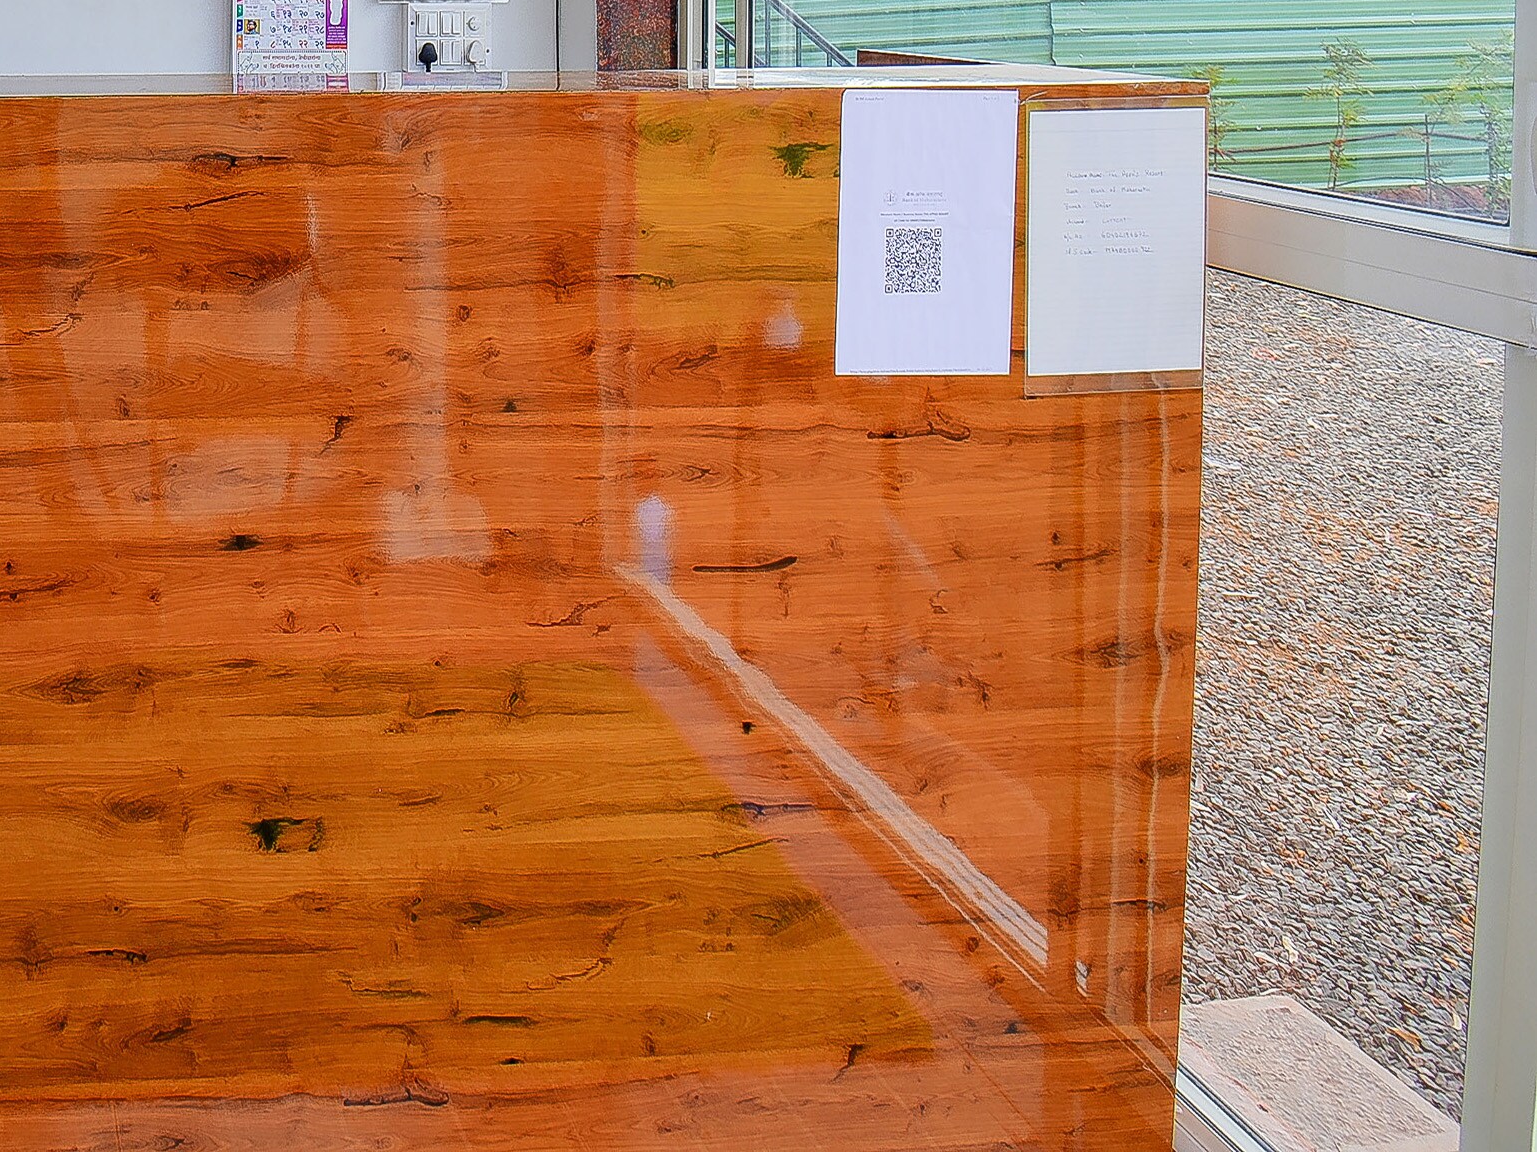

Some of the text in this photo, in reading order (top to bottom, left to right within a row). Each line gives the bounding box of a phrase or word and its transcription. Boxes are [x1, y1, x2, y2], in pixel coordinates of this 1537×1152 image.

[271, 10, 325, 19] ६ १३ २० २७
[283, 25, 291, 33] १४
[299, 25, 307, 34] २१
[315, 26, 324, 34] २८
[283, 40, 292, 48] १५
[299, 40, 308, 48] २२
[315, 41, 324, 49] २९
